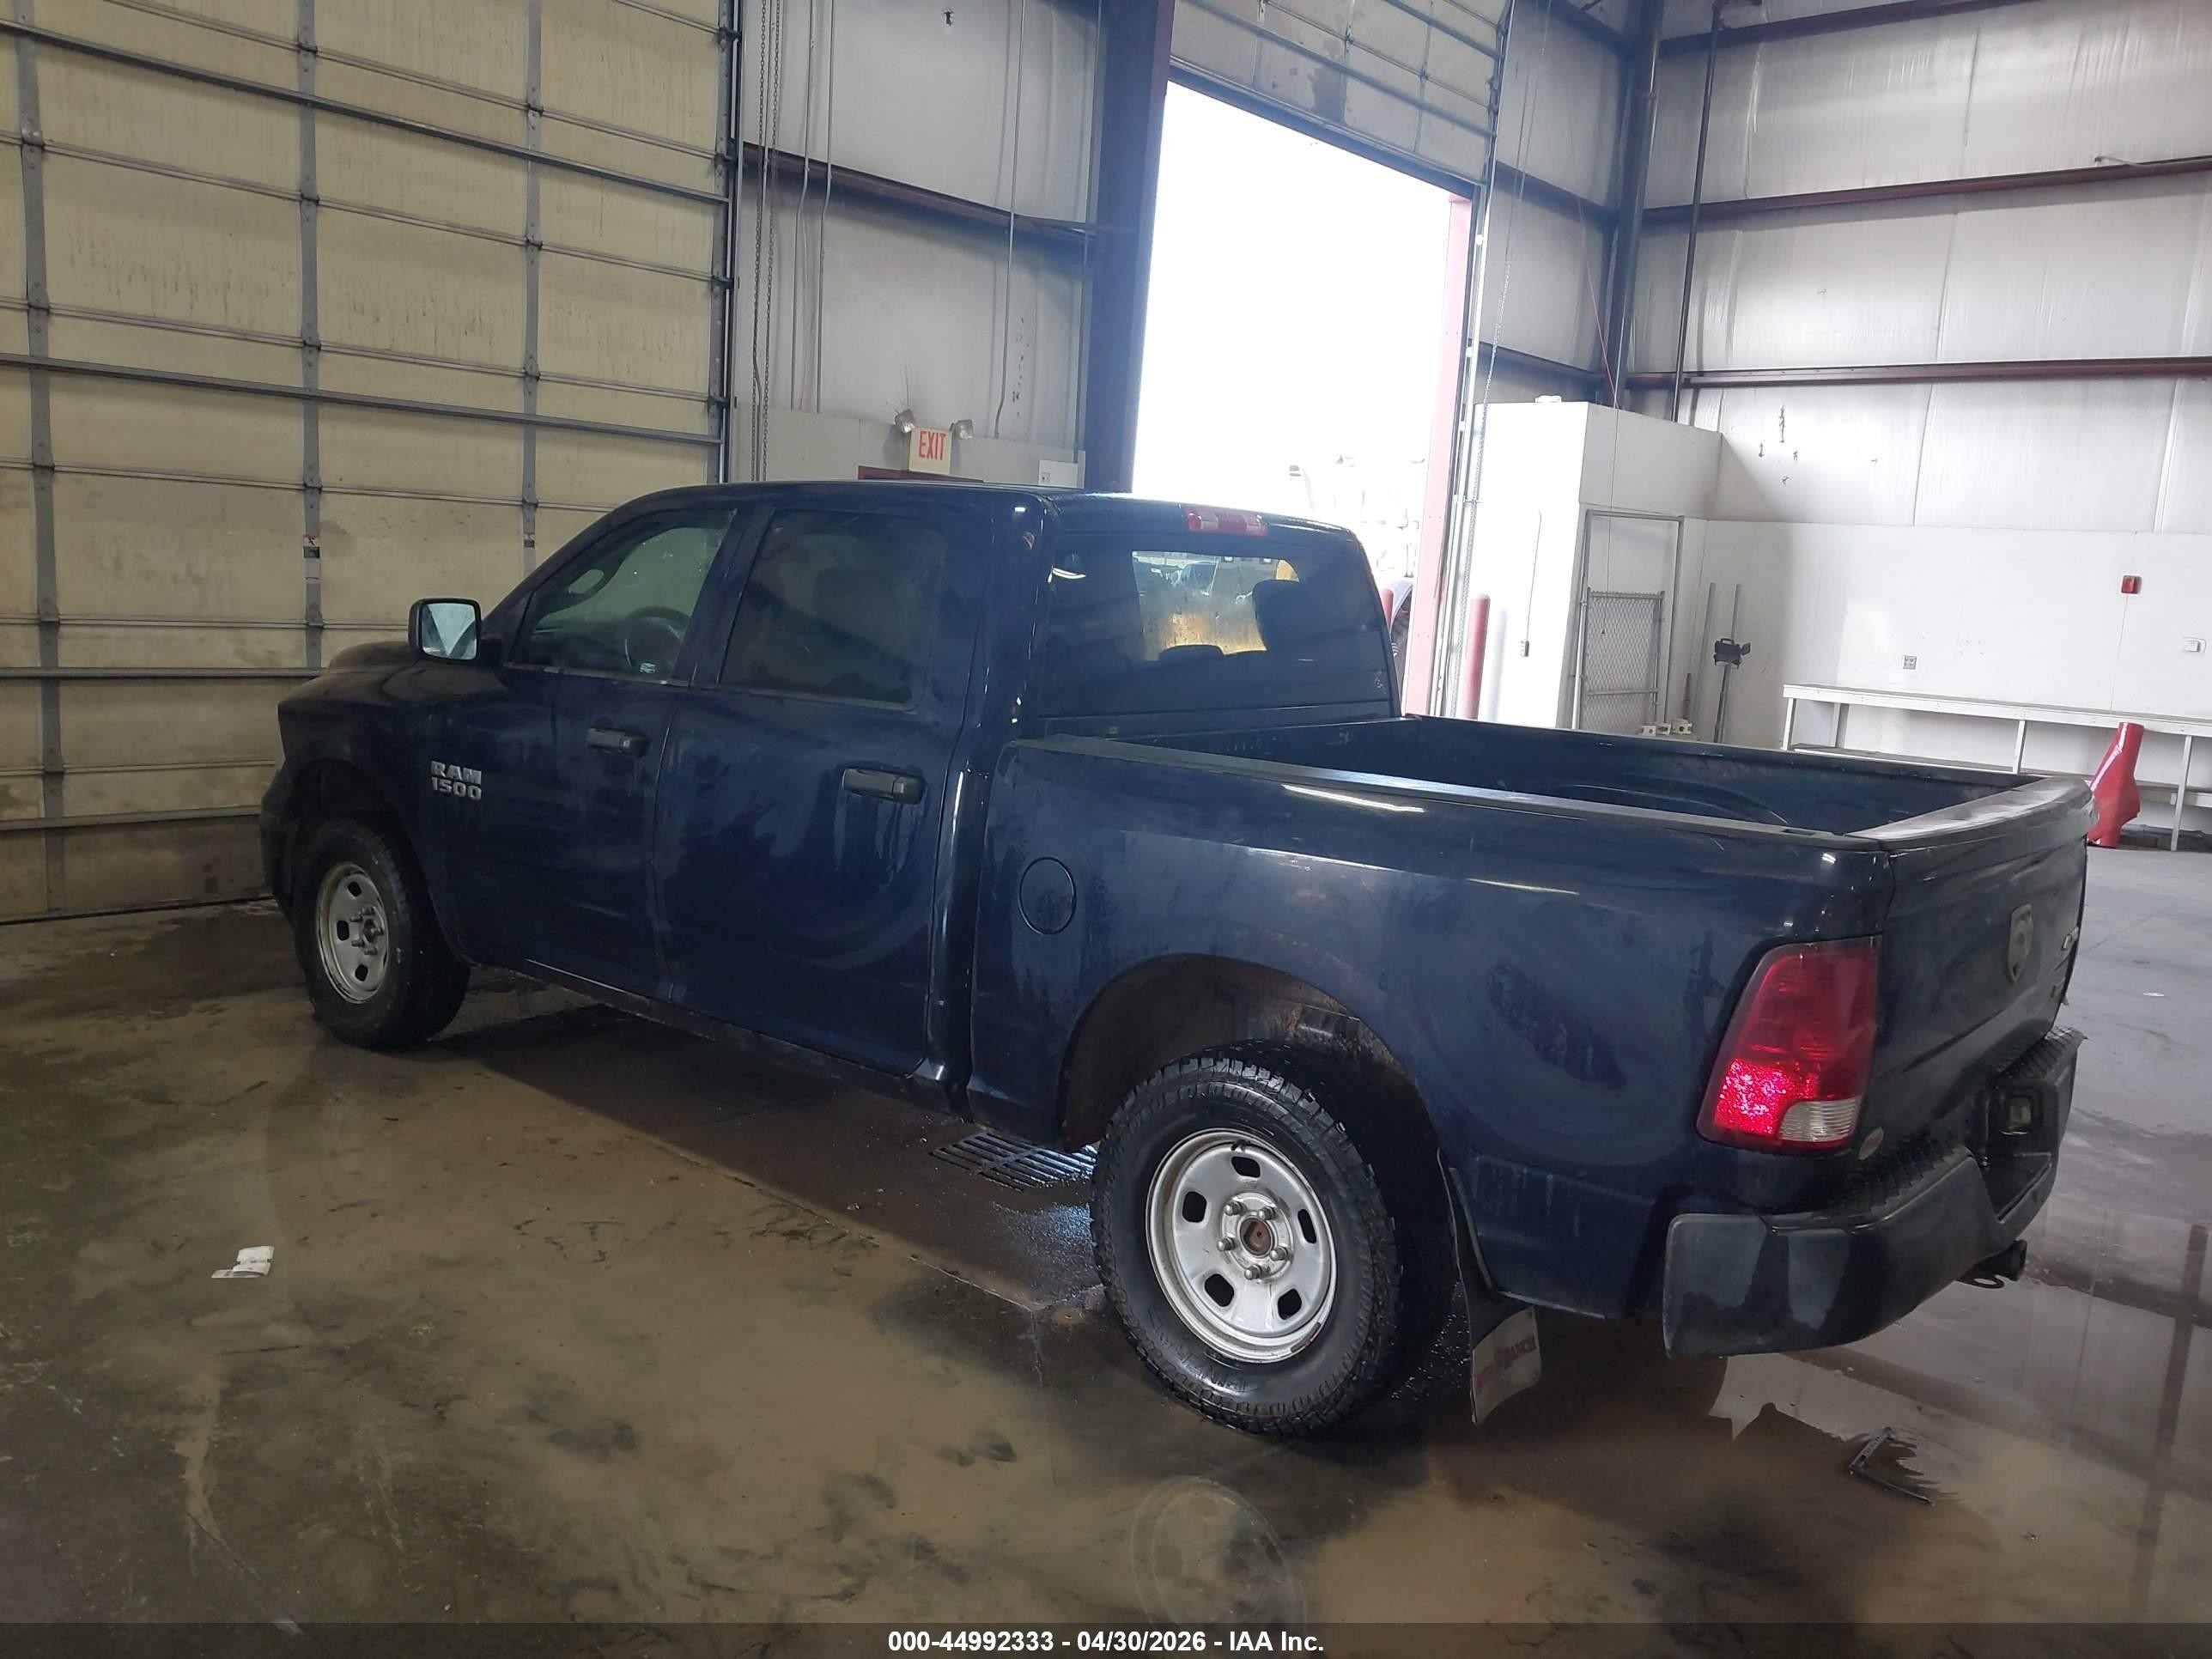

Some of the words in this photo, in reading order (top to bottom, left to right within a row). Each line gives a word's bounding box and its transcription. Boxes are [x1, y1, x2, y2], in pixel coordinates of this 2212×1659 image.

[919, 430, 946, 460] EXIT
[431, 761, 482, 785] RAM
[431, 776, 482, 800] 1500
